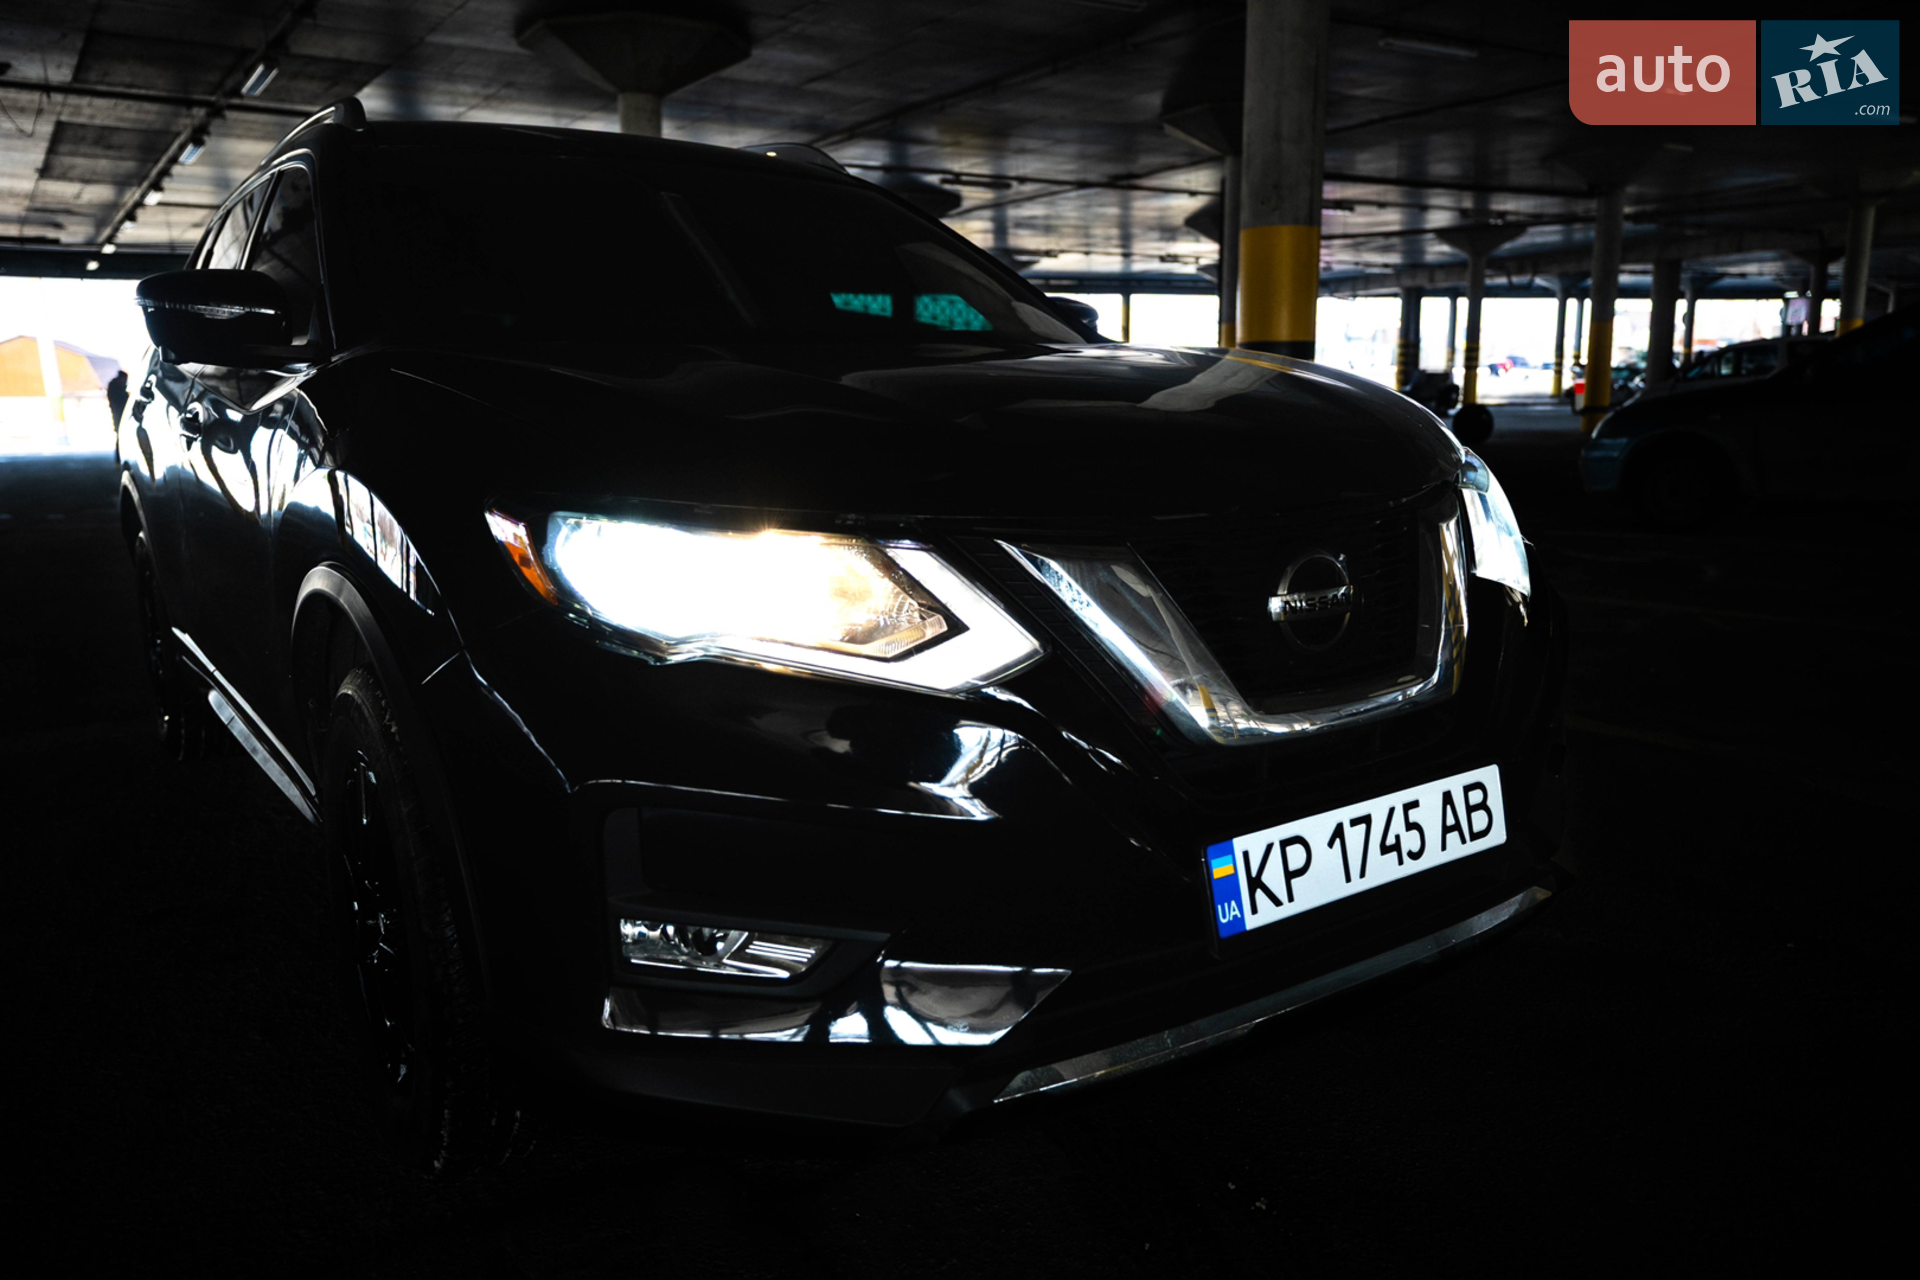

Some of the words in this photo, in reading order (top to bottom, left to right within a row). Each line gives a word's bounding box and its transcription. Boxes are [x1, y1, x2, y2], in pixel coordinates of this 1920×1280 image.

[1284, 592, 1352, 616] NISSAN
[1242, 835, 1312, 915] KP
[1327, 800, 1426, 883] 1745
[1441, 782, 1493, 852] AB
[1217, 899, 1241, 924] UA
